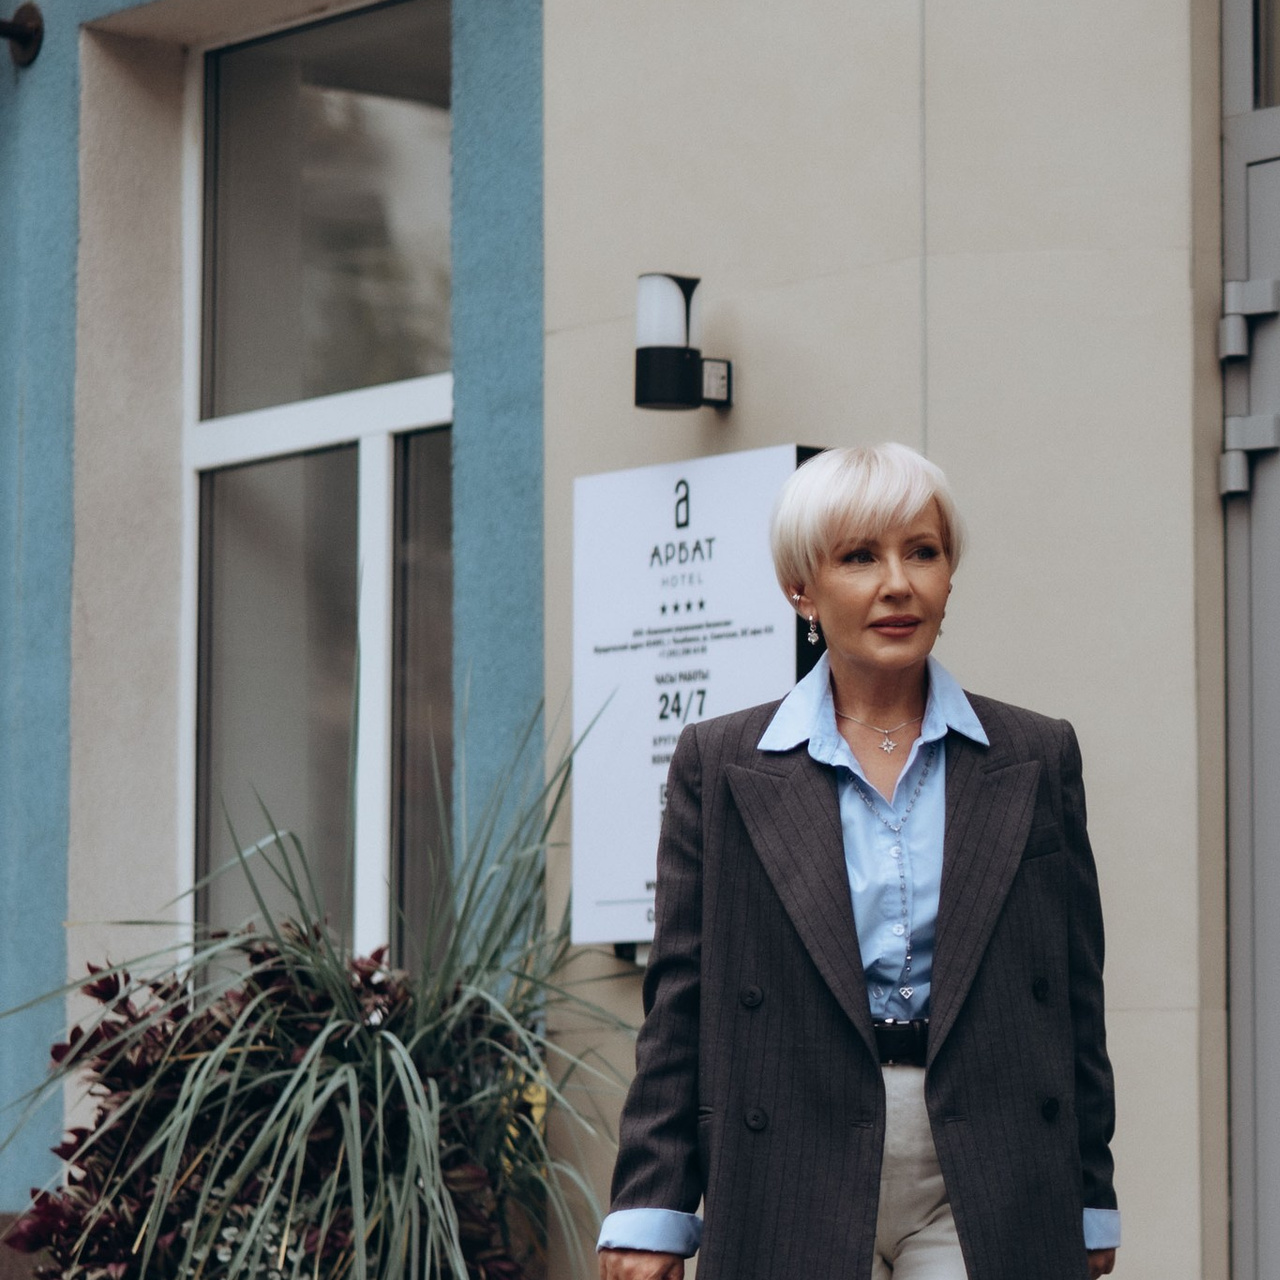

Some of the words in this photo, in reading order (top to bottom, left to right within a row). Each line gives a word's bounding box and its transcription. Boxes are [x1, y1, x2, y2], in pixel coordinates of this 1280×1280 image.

[650, 537, 716, 567] АРБАТ
[661, 574, 704, 589] HOTEL
[659, 689, 706, 724] 24/7
